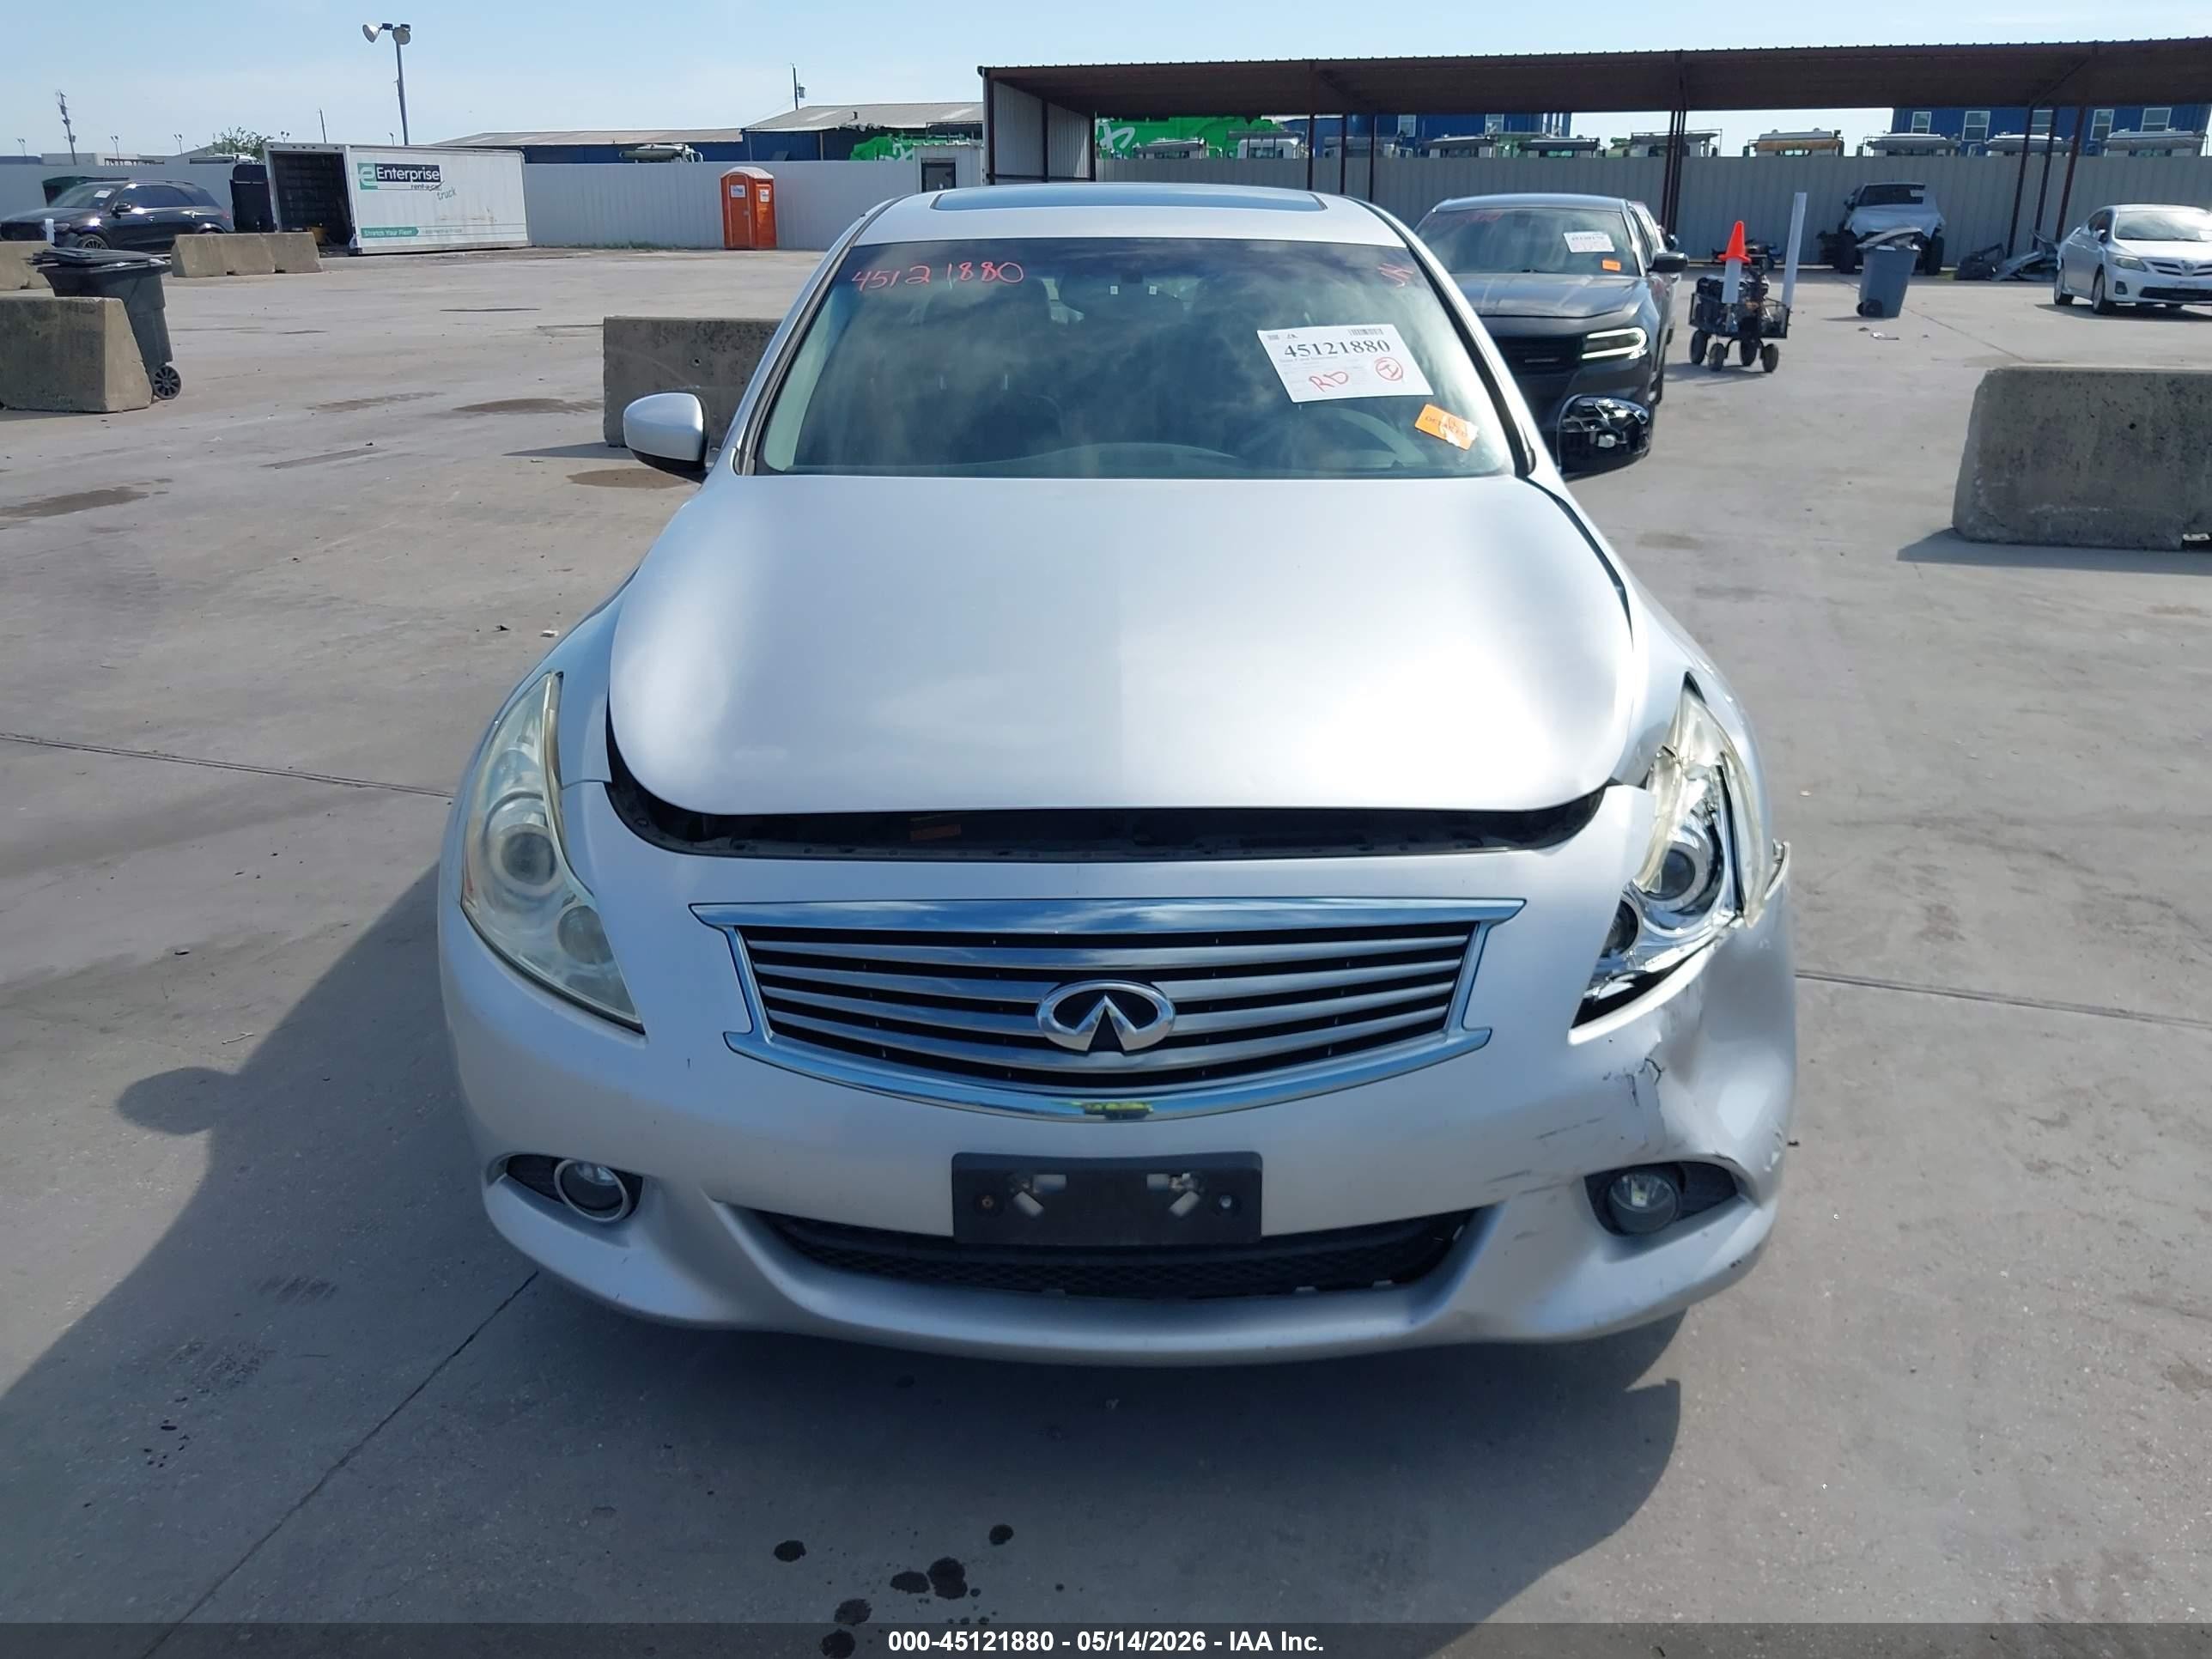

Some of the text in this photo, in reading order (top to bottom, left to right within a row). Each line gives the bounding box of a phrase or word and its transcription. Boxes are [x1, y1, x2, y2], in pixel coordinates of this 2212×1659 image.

[377, 167, 440, 183] Enterprise
[437, 188, 457, 200] truck
[852, 260, 1024, 291] 45121880
[1284, 339, 1391, 358] 45121880
